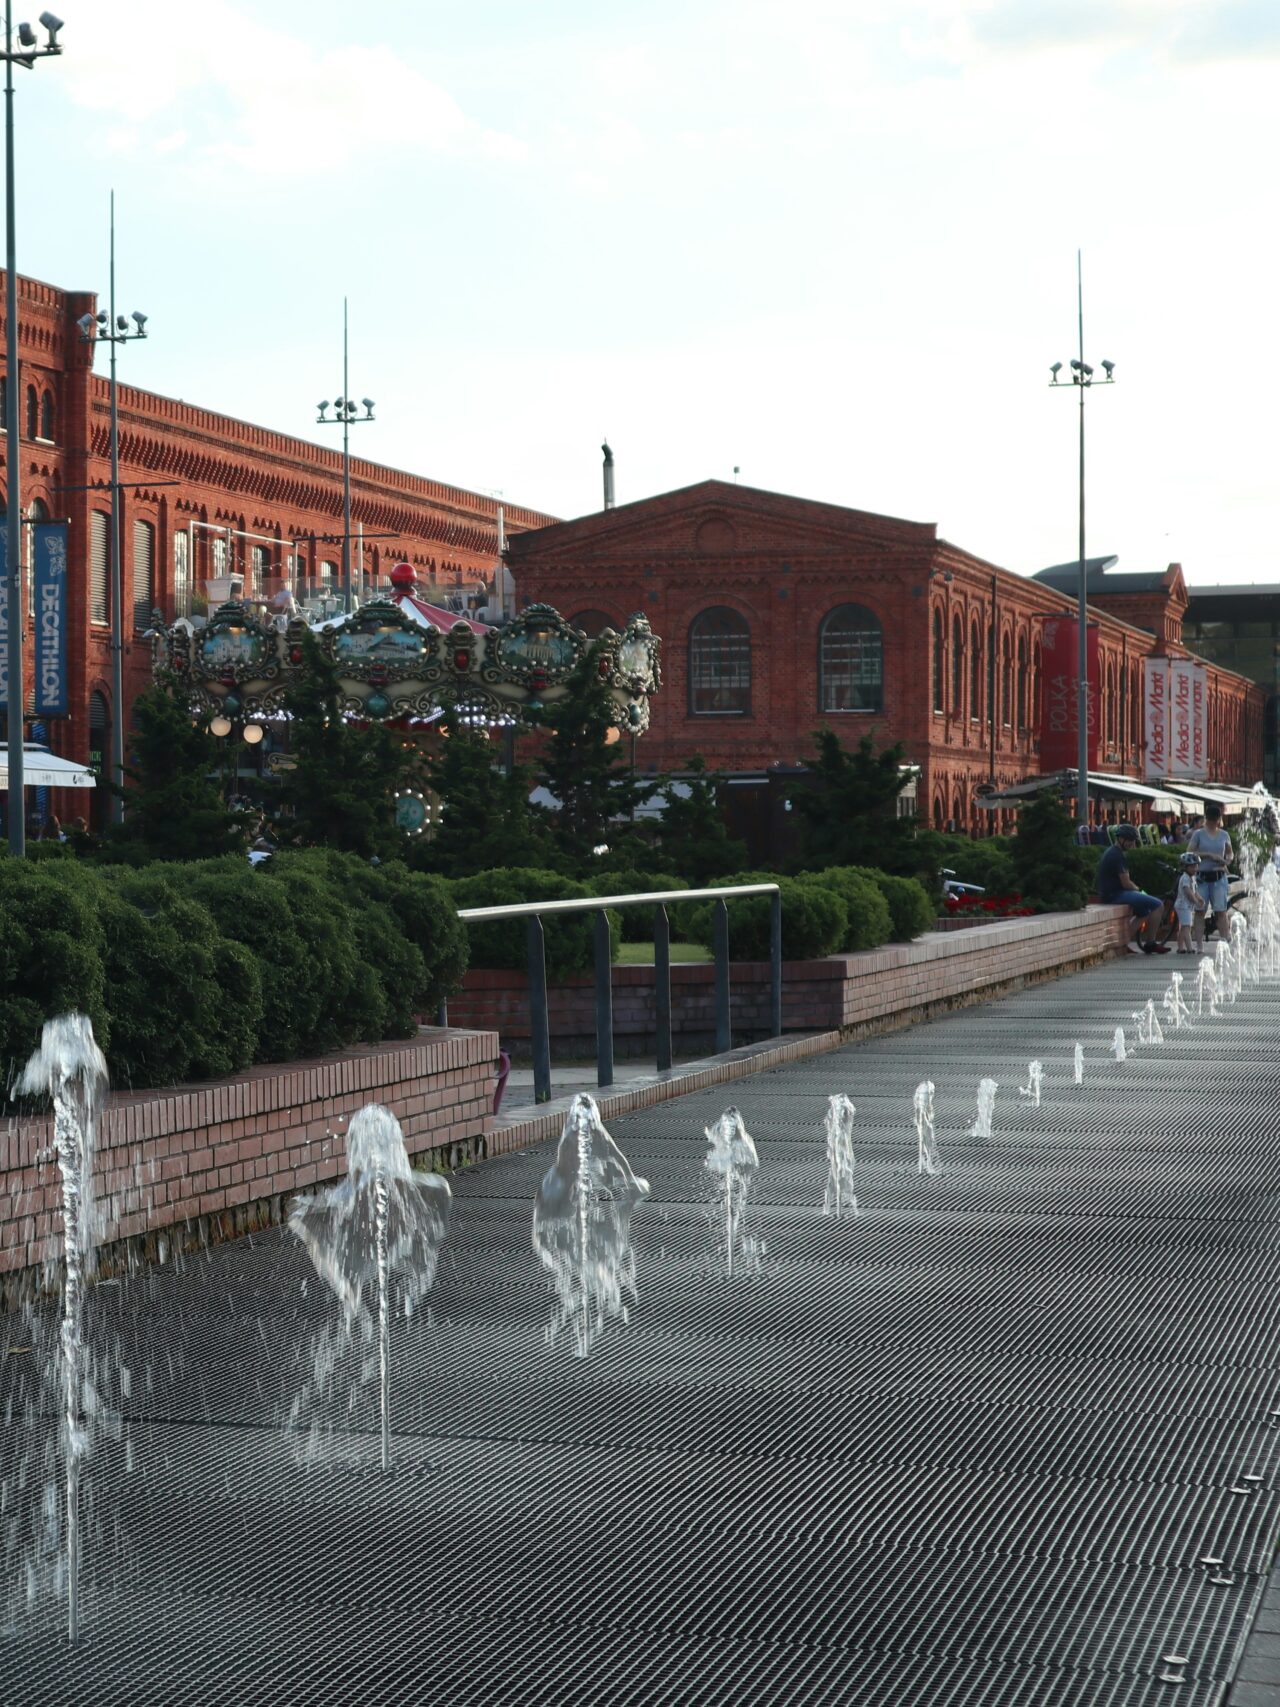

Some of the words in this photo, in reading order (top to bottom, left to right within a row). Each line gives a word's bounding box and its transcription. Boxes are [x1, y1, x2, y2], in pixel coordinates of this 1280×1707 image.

[41, 584, 60, 706] DECATHLON
[1050, 674, 1068, 732] POLKA
[1149, 671, 1164, 713] Markt
[1175, 673, 1189, 713] Markt
[1149, 724, 1164, 770] Media
[1175, 724, 1189, 767] Media
